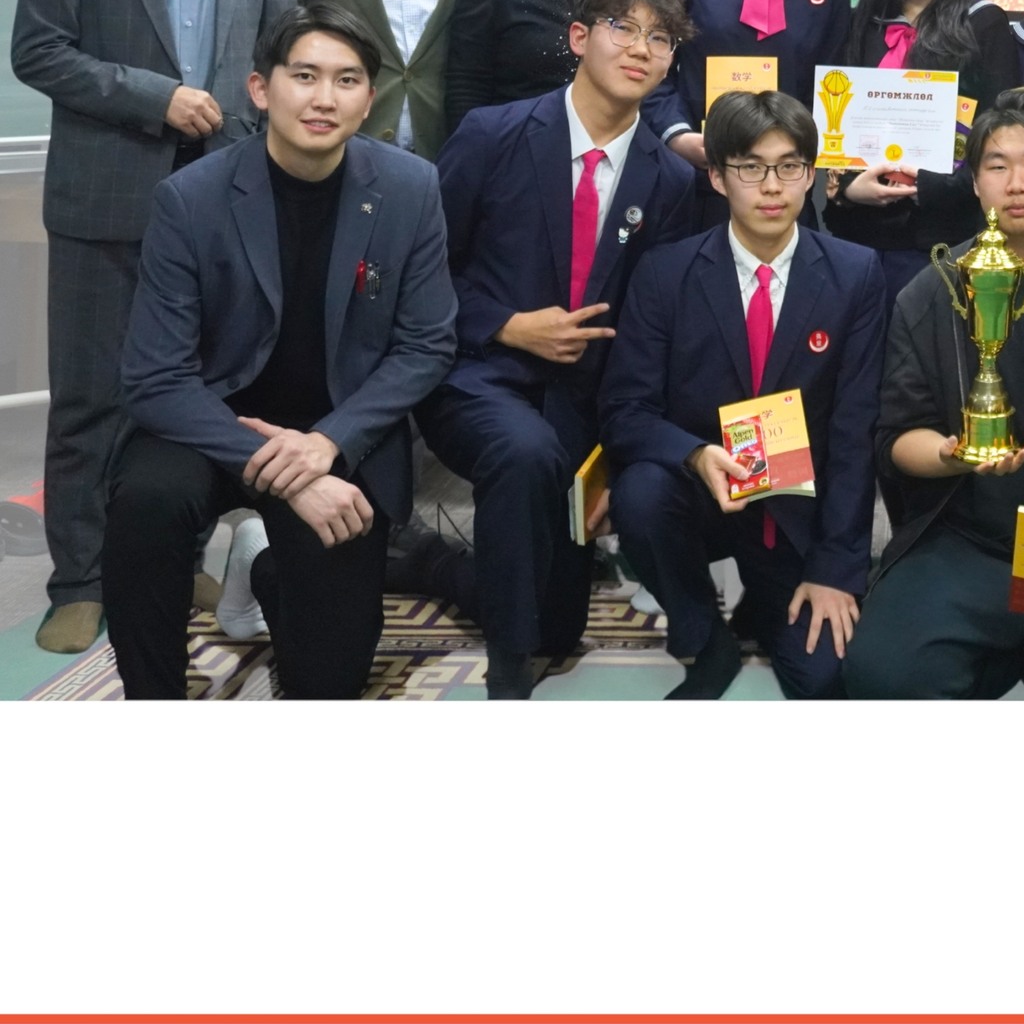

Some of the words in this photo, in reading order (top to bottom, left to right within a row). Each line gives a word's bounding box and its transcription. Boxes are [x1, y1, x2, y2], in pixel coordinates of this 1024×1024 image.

[731, 72, 752, 82] 数学
[867, 90, 934, 101] ӨРГӨМЖЛӨЛ
[732, 428, 754, 438] Alpen
[734, 435, 753, 445] Gold
